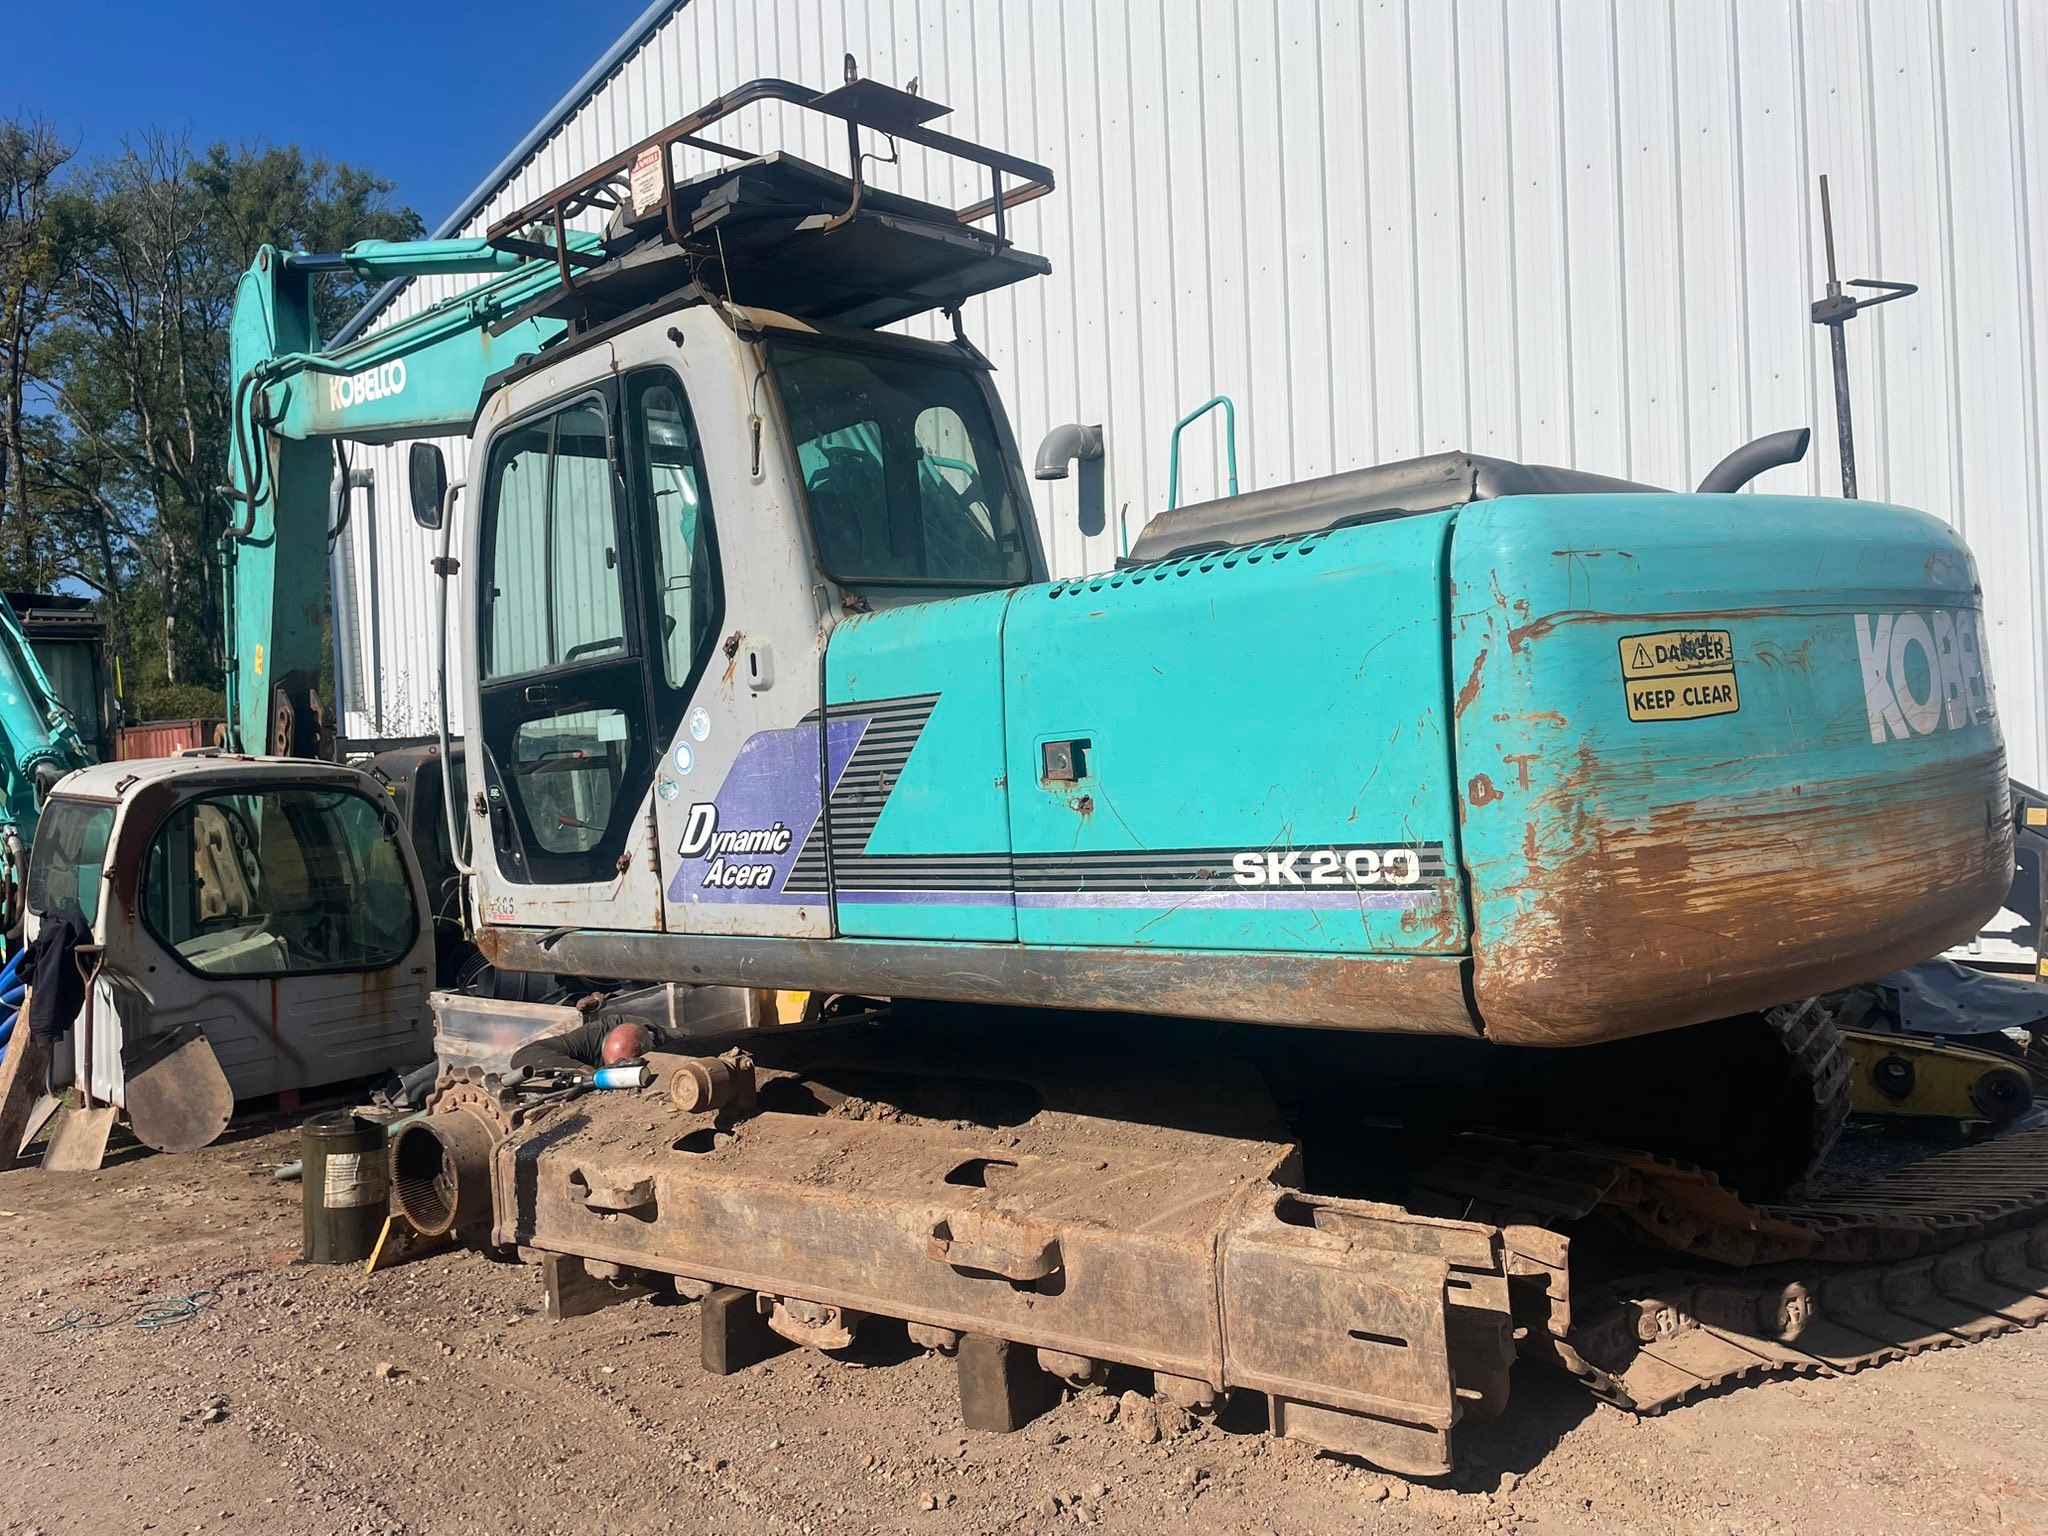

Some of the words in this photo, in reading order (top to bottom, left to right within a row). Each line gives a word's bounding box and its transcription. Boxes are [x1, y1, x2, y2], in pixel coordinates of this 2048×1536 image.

[329, 358, 406, 411] KOBELCO
[1633, 689, 1676, 711] KEEP
[1683, 684, 1732, 706] CLEAR
[678, 802, 793, 863] Dynamic
[701, 857, 776, 890] Acera
[1232, 849, 1420, 886] SK200
